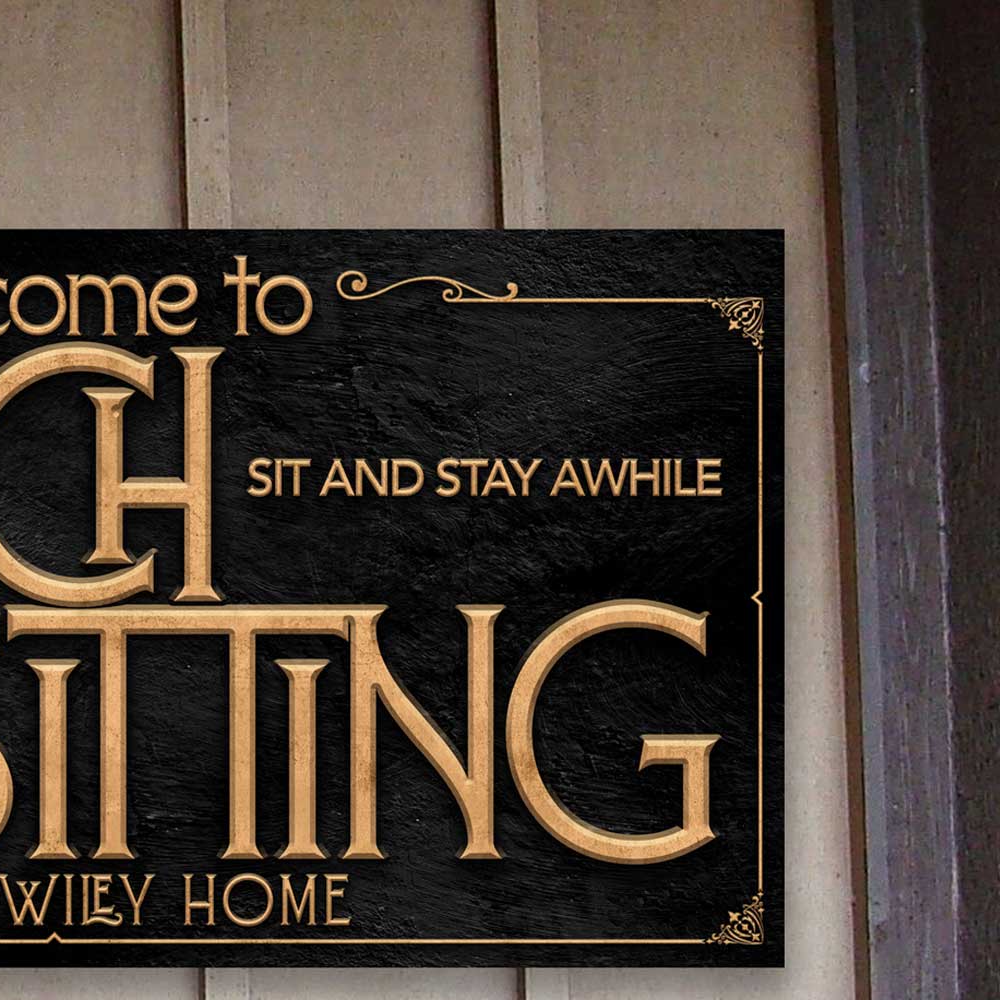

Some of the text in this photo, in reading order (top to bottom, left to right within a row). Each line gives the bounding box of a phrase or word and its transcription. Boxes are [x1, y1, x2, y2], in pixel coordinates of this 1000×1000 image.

[223, 254, 314, 337] to
[247, 457, 723, 497] SIT AND STAY AWHILE
[183, 873, 351, 926] HOME
